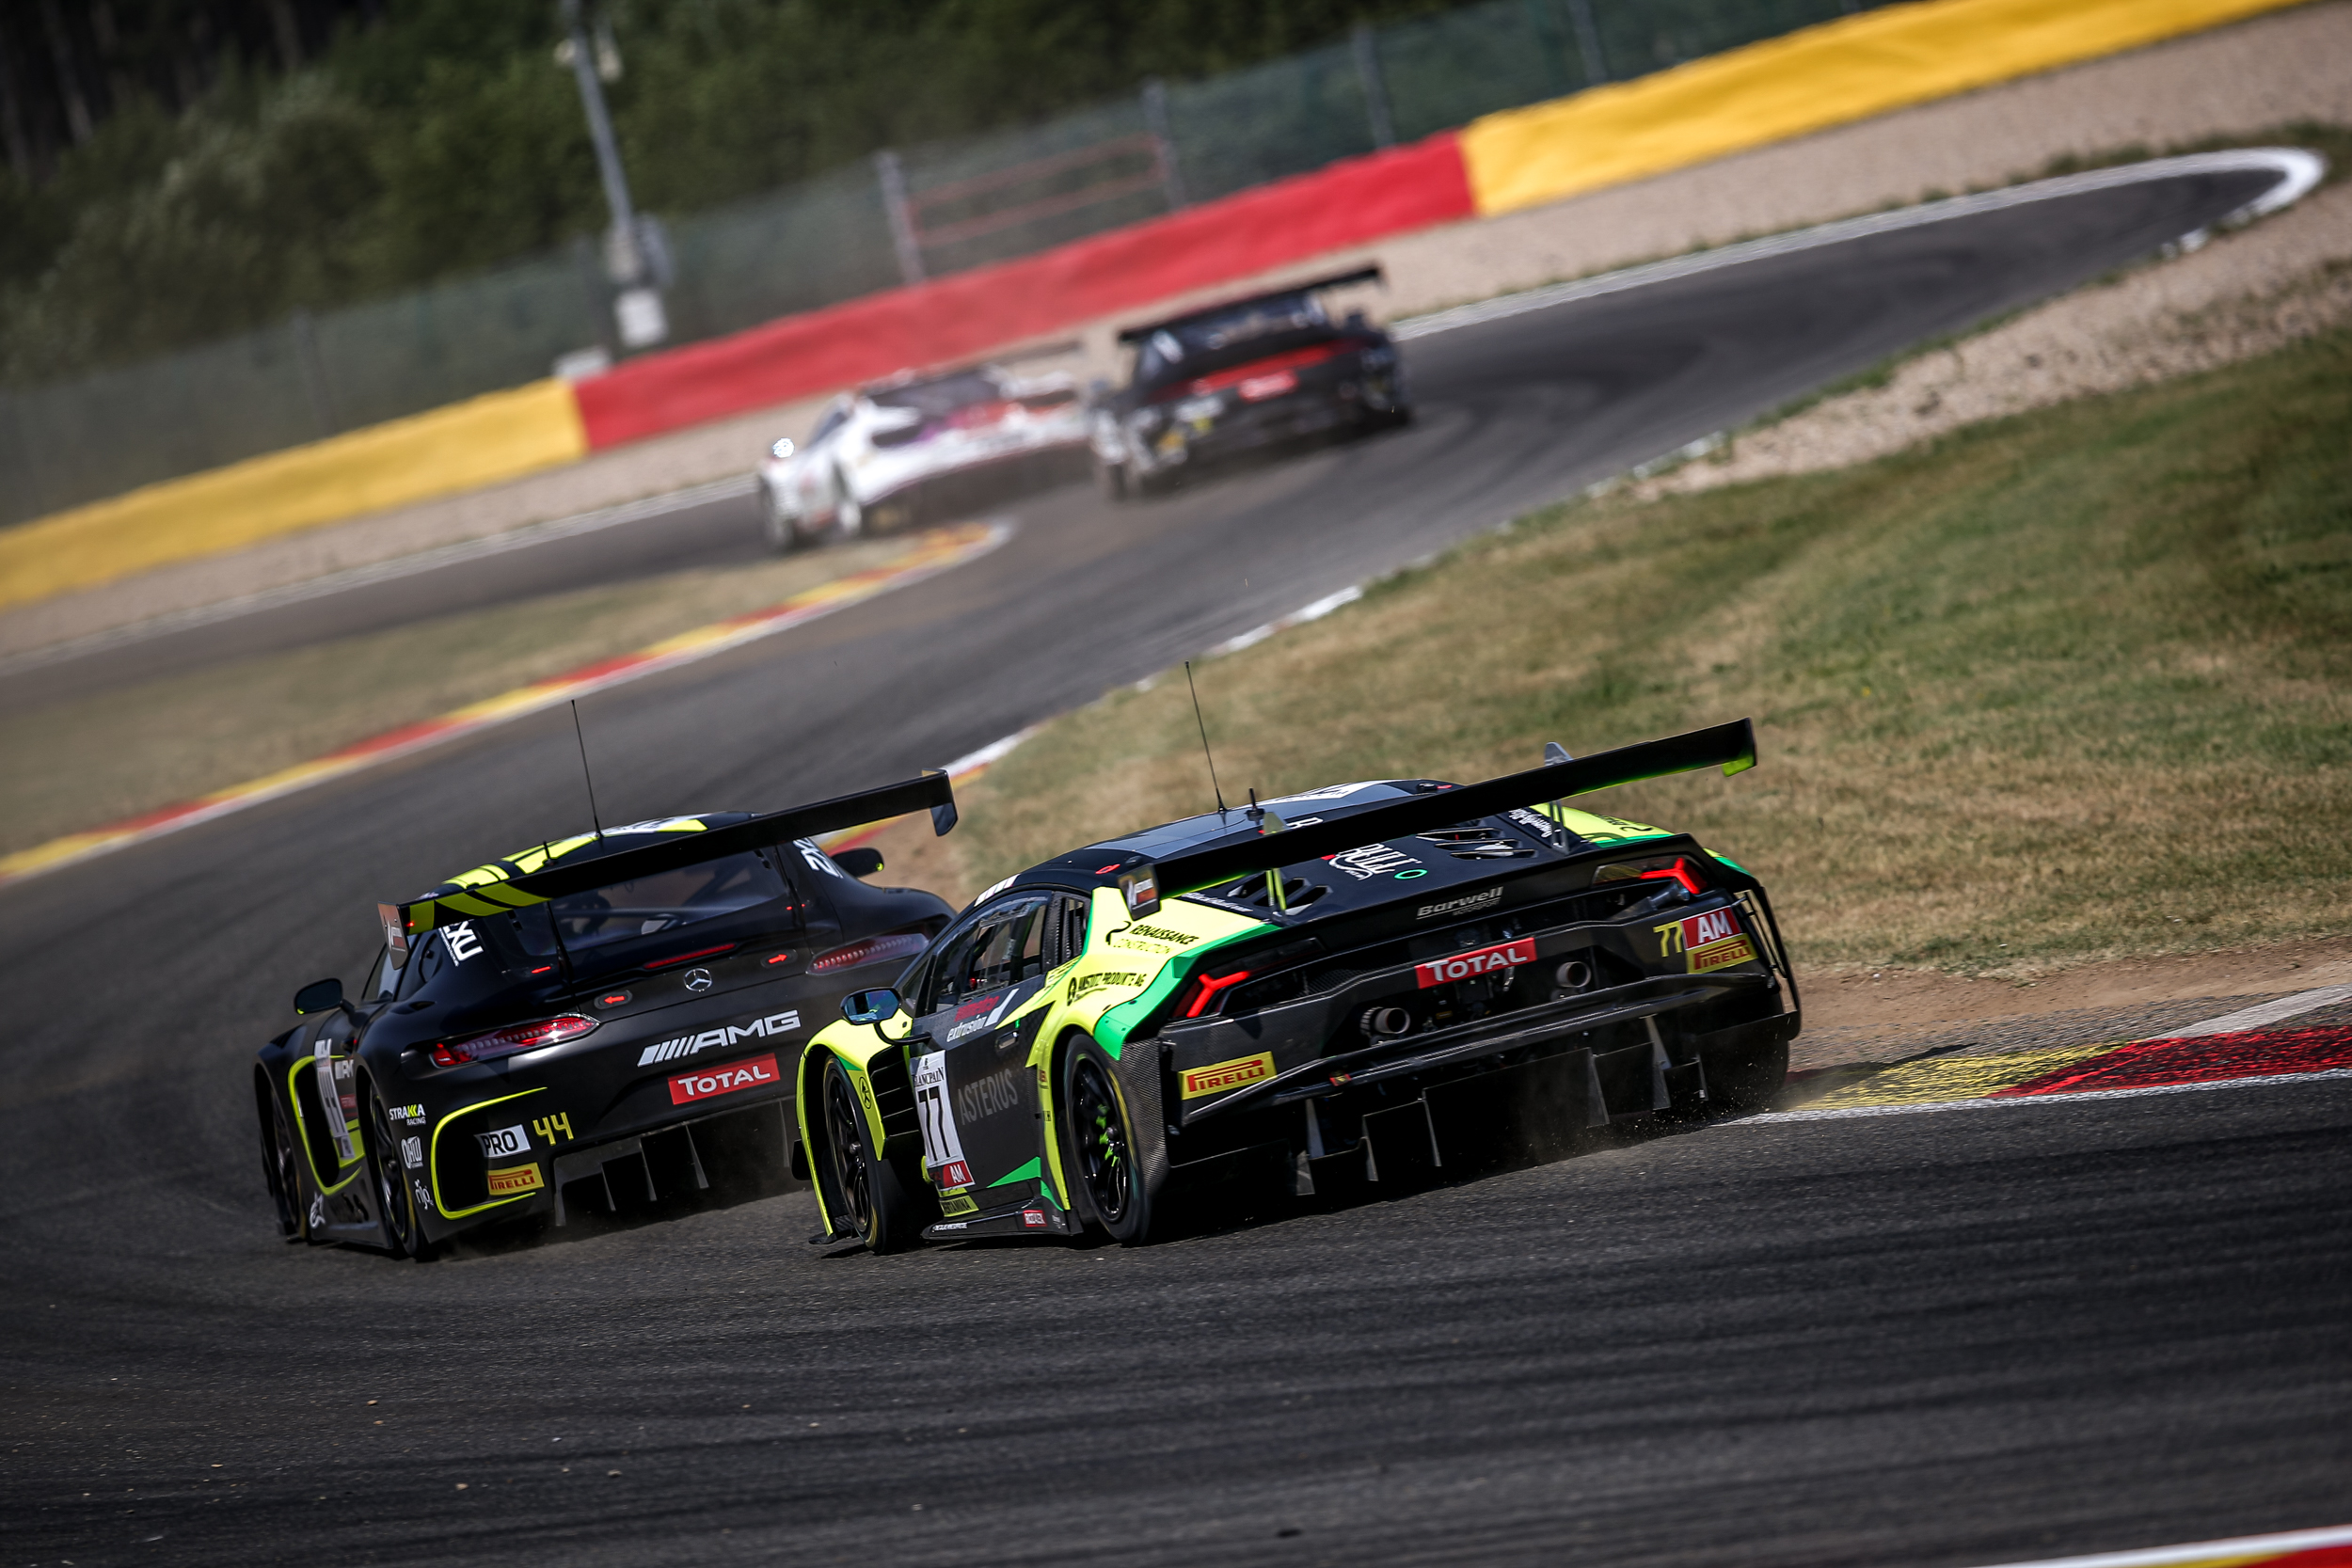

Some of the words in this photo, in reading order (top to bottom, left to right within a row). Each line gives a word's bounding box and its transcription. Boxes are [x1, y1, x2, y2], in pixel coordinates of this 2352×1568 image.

[1417, 886, 1503, 917] Barwell
[1129, 924, 1200, 945] RENAISSANCE
[1653, 920, 1682, 958] 77
[1697, 911, 1733, 943] AM
[1425, 948, 1528, 981] TOTAL
[1693, 939, 1751, 970] PIRELLI
[677, 1066, 771, 1096] TOTAL
[1186, 1059, 1264, 1092] PIRELLI
[389, 1103, 426, 1120] STRAKKA
[958, 1069, 1019, 1126] ASTERUS
[406, 1117, 426, 1126] RACING
[532, 1112, 574, 1146] 44
[917, 1085, 951, 1162] 77
[480, 1130, 518, 1155] PRO
[487, 1169, 535, 1190] PIRELLI
[949, 1164, 966, 1183] AM
